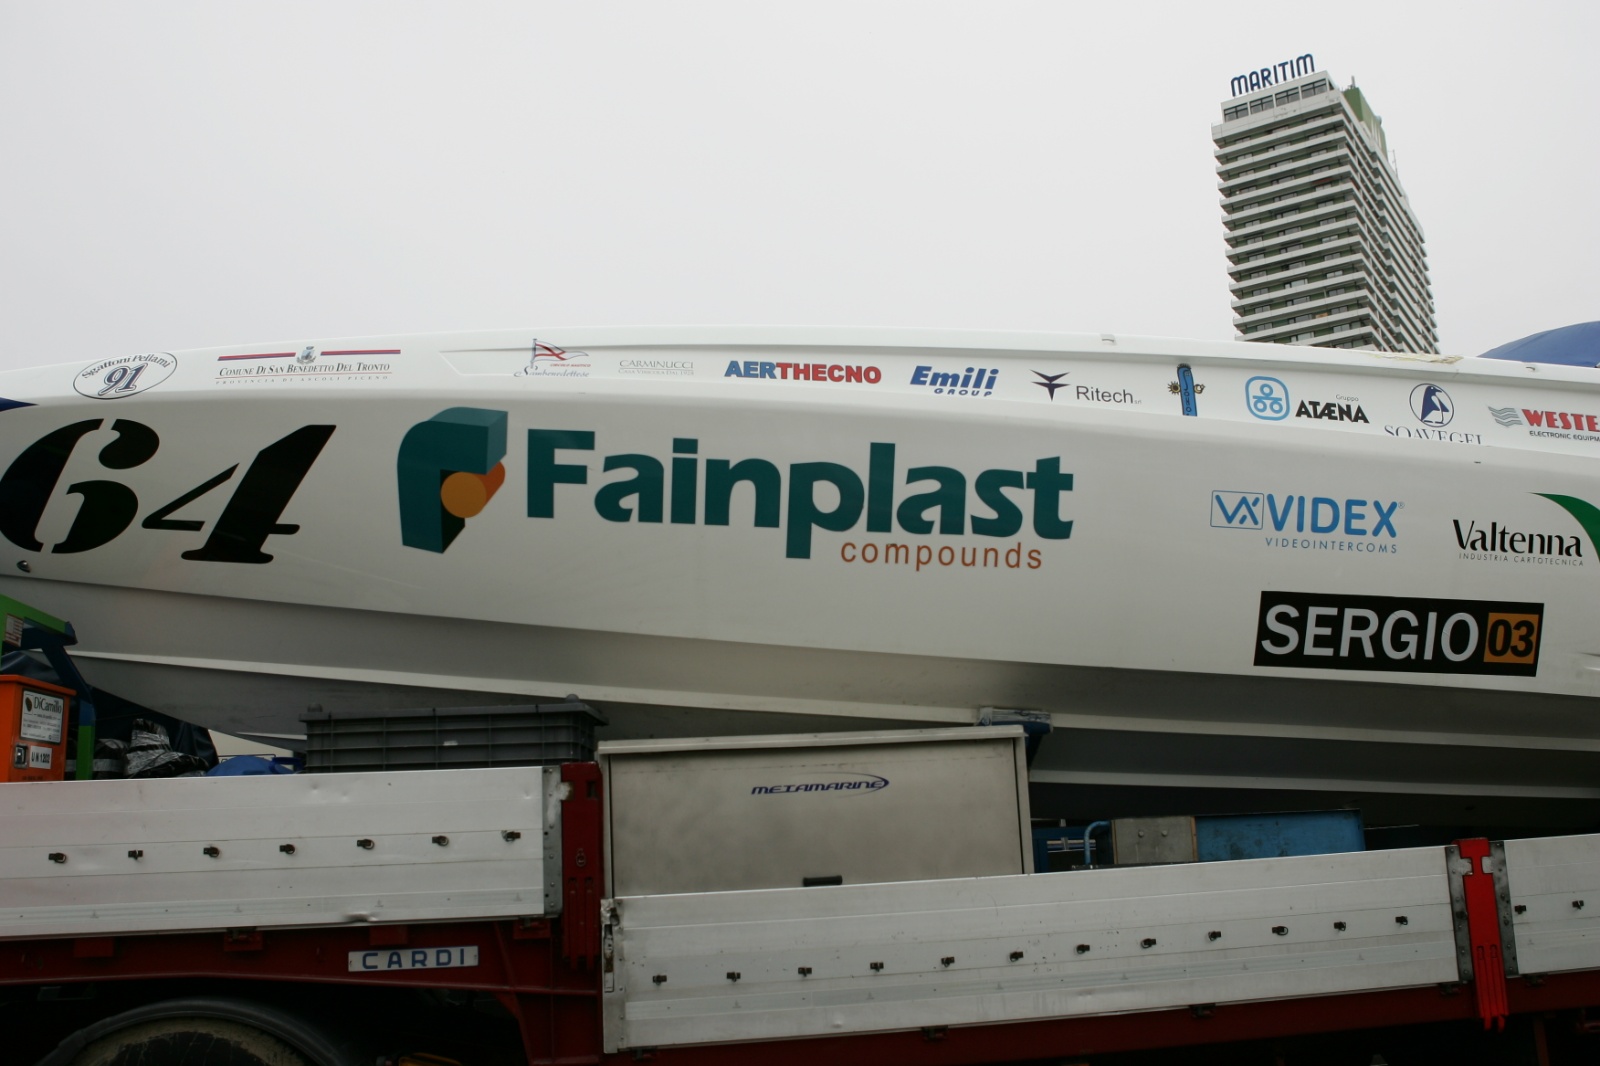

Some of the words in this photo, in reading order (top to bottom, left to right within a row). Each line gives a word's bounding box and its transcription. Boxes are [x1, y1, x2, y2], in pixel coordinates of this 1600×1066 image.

[1230, 53, 1315, 97] MARITIM
[81, 355, 131, 379] Sgattoni
[131, 354, 171, 368] Pellami
[619, 359, 694, 369] CARMINUCCI
[724, 360, 882, 384] AERTHECNO
[98, 362, 148, 396] 91
[910, 365, 999, 390] Emili
[934, 388, 993, 397] GROUP
[1076, 385, 1133, 404] Ritech
[1335, 394, 1359, 402] Gruppo
[1529, 430, 1571, 440] ELECTRONIC
[0, 418, 337, 564] 64
[527, 428, 1074, 560] Fainplast
[1266, 493, 1398, 538] VIDEX
[1265, 537, 1398, 554] VIDEOINTERCOMS
[1453, 519, 1583, 557] Valtenna
[840, 542, 1042, 572] compounds
[1459, 553, 1509, 562] INDUSTRIA
[1513, 556, 1584, 567] CARTOTECNICA
[1260, 604, 1479, 662] SERGIO
[1488, 619, 1535, 658] 03
[362, 948, 465, 970] CARDI
